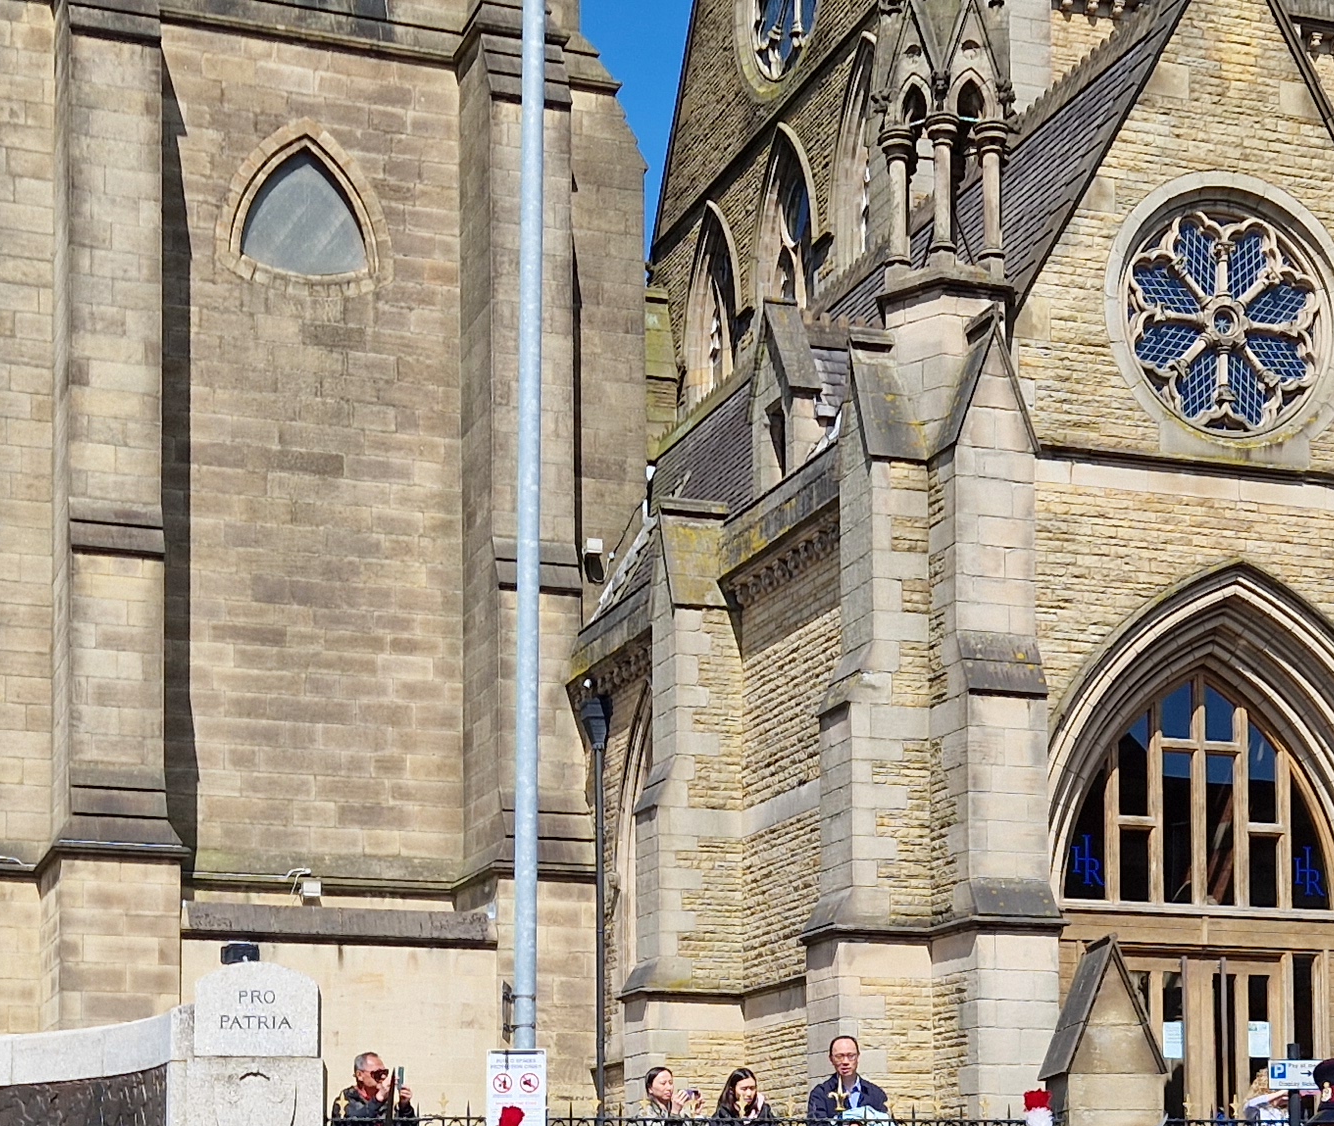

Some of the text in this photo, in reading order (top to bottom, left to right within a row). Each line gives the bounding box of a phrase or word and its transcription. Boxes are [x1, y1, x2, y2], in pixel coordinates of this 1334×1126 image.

[238, 990, 276, 1004] PRO
[220, 1014, 292, 1030] PATRIA
[1273, 1063, 1285, 1078] P
